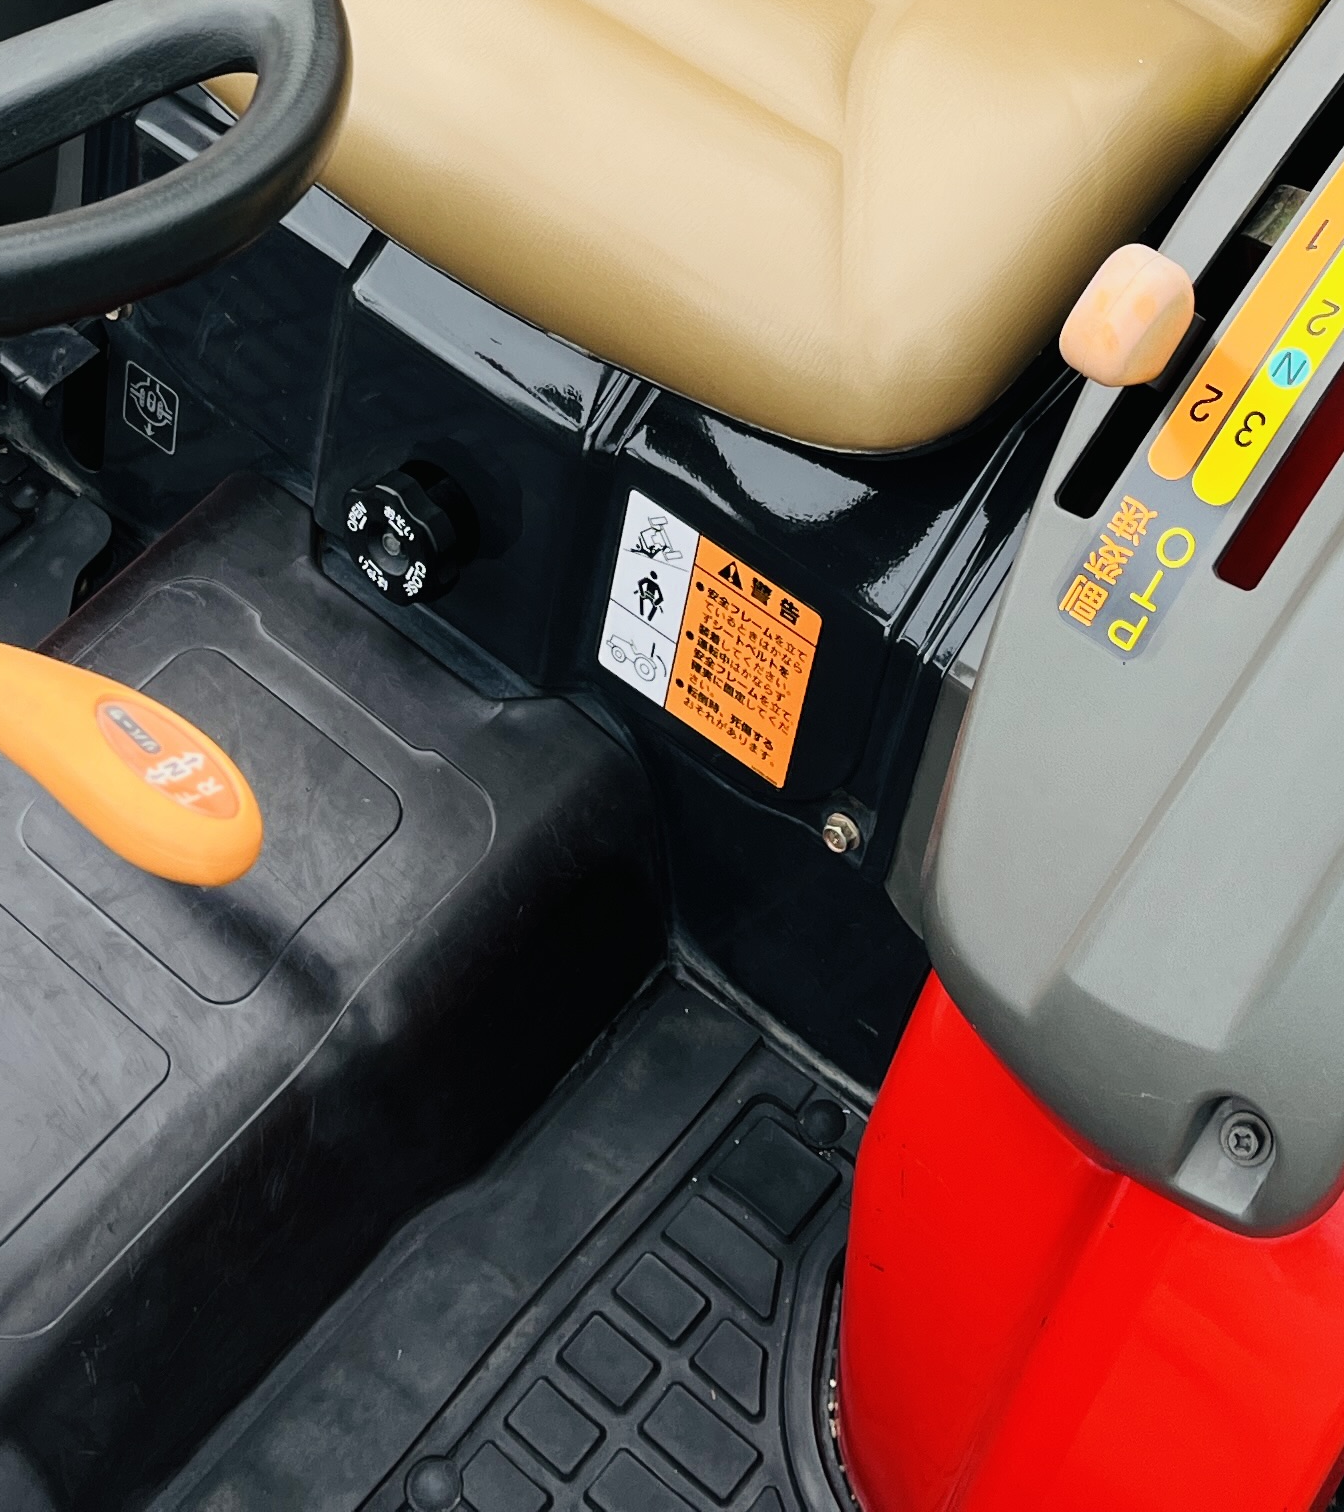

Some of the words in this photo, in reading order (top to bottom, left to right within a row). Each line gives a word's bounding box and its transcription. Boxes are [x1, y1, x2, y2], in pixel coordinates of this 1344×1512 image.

[1305, 219, 1330, 251] 1
[1305, 298, 1341, 337] 2
[1271, 351, 1308, 386] N
[1189, 383, 1224, 422] 2
[1233, 410, 1267, 448] 3
[1057, 493, 1160, 627] 副変速
[748, 575, 802, 627] 警告
[1106, 525, 1197, 652] PTO
[699, 611, 791, 681] ずシートベルトを
[702, 598, 805, 676] ているときはかなら
[704, 585, 809, 665] 安全フレームを立て
[694, 635, 787, 705] 運転中はかならず
[196, 775, 226, 797] R
